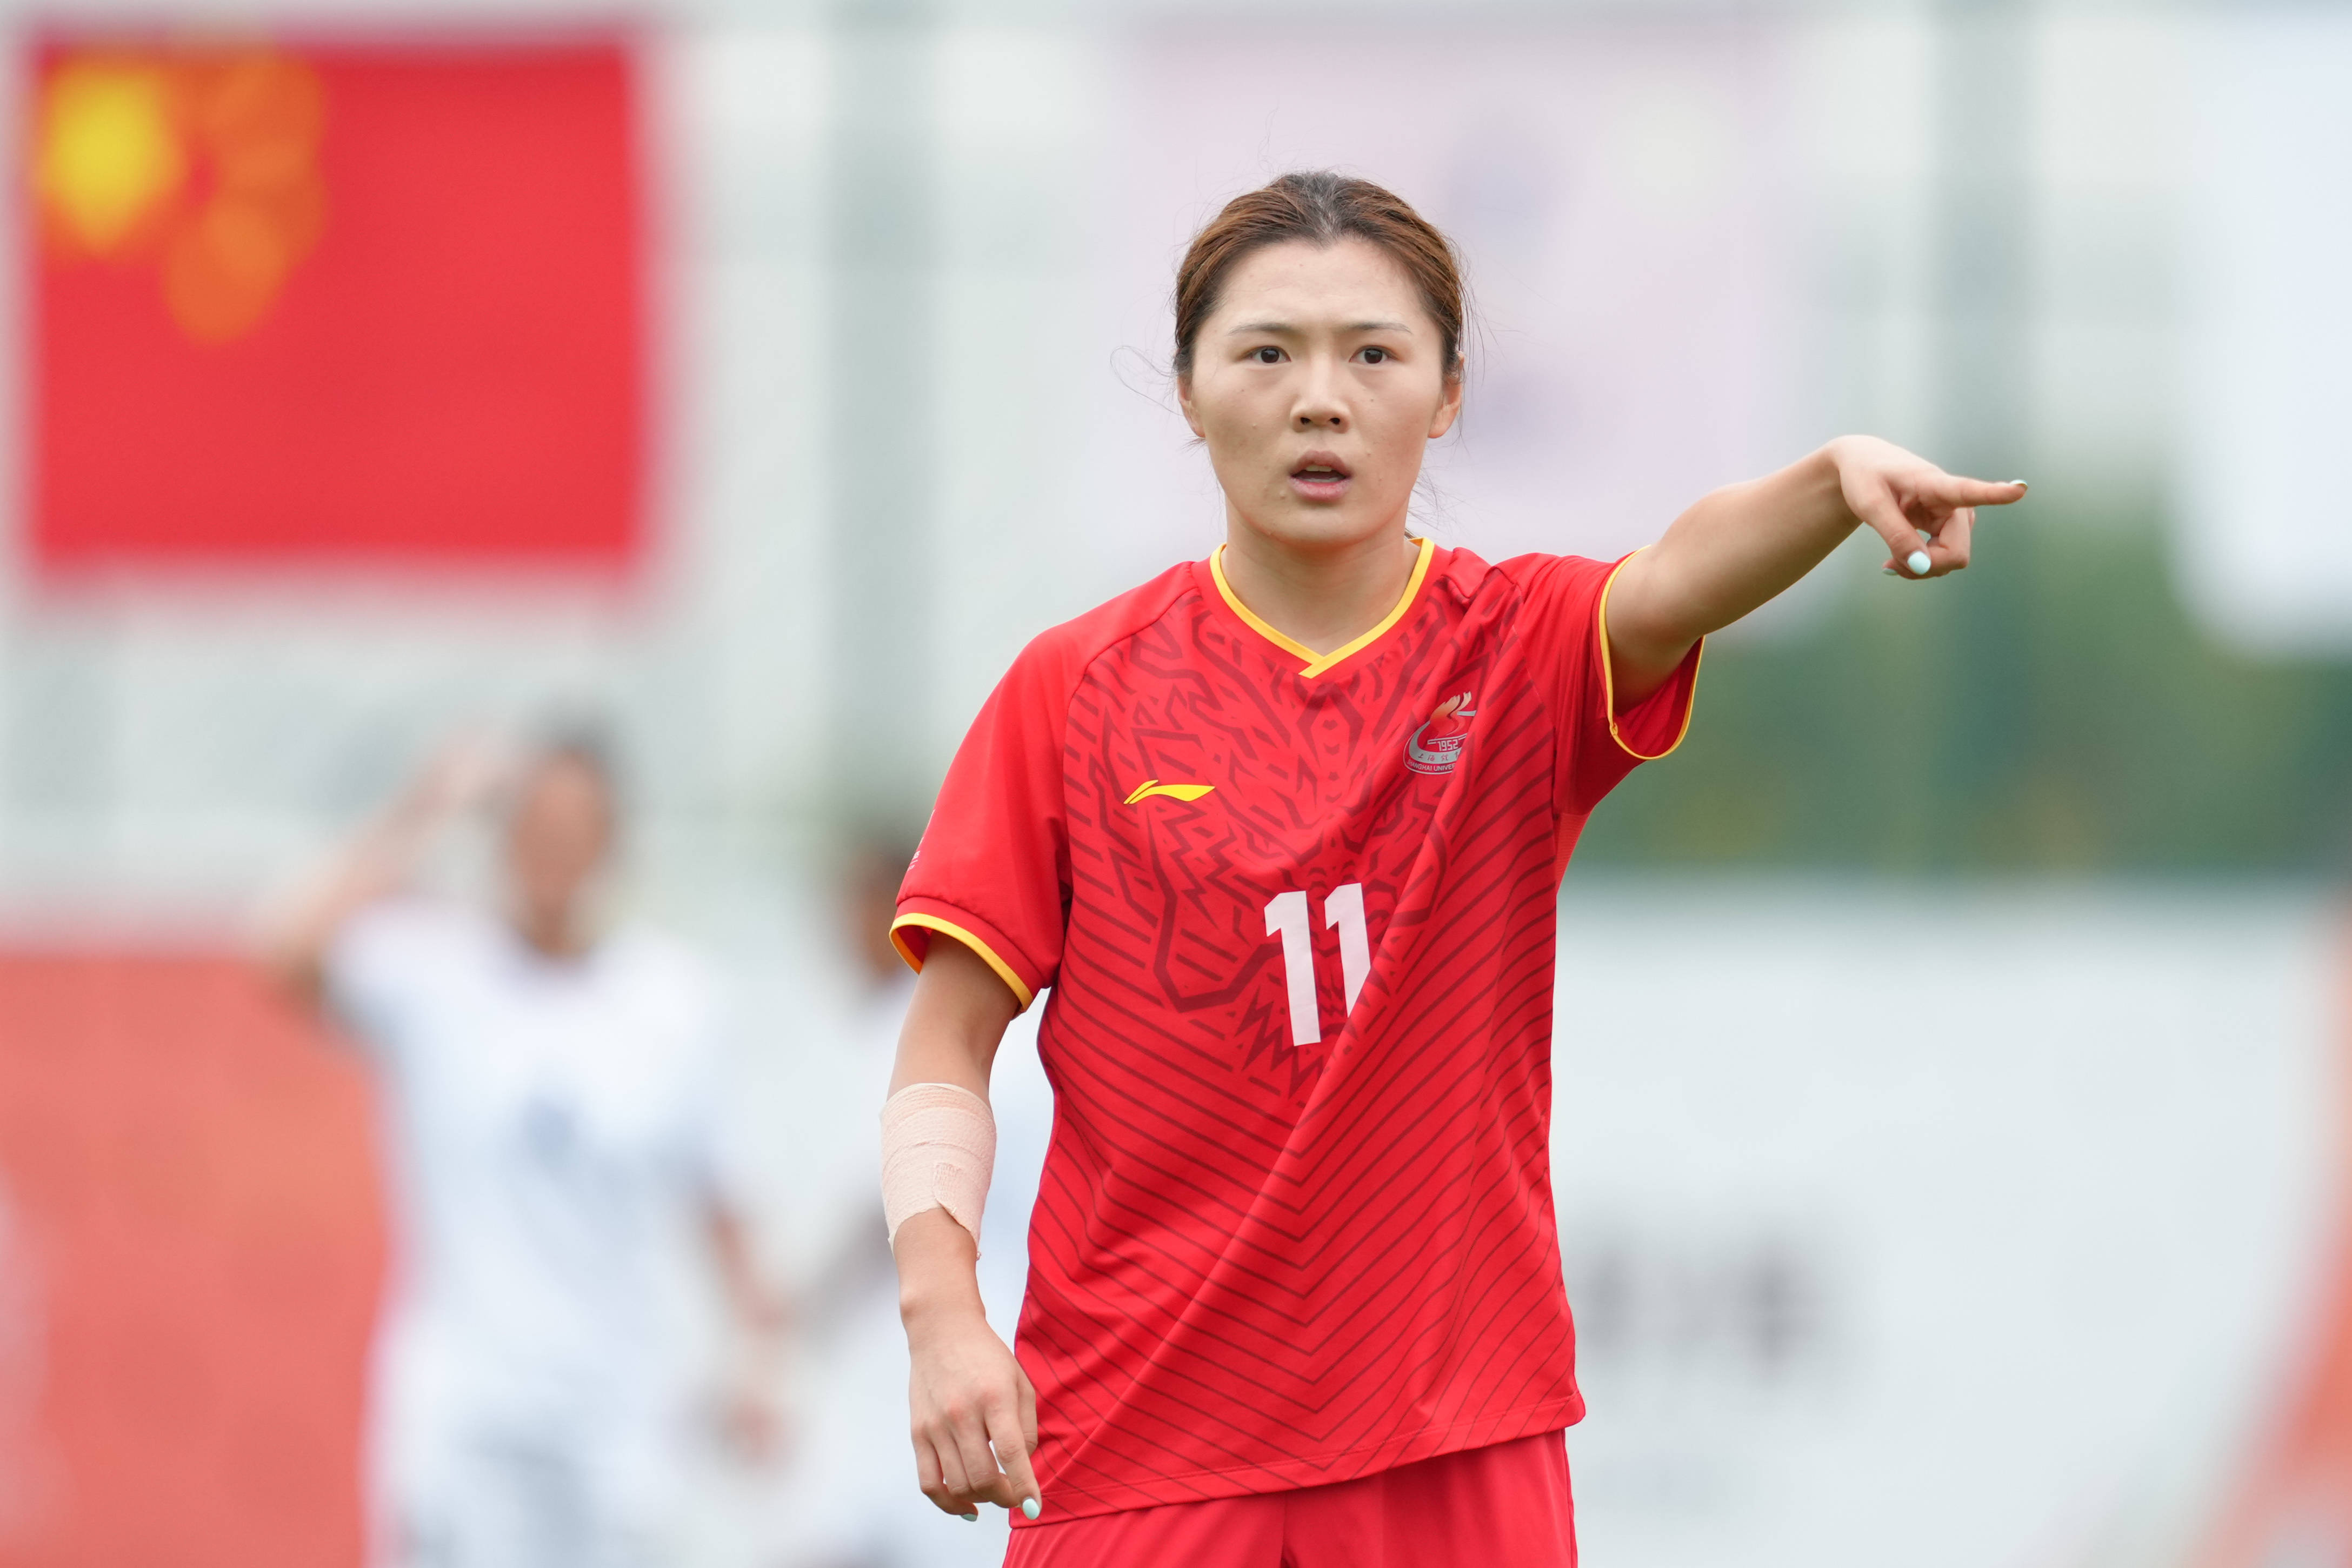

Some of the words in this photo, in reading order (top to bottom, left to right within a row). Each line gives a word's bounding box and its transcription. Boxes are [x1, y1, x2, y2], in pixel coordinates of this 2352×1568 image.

[1437, 740, 1458, 751] 1952
[1407, 759, 1432, 771] SHANGHAI
[1264, 883, 1371, 1046] 11
